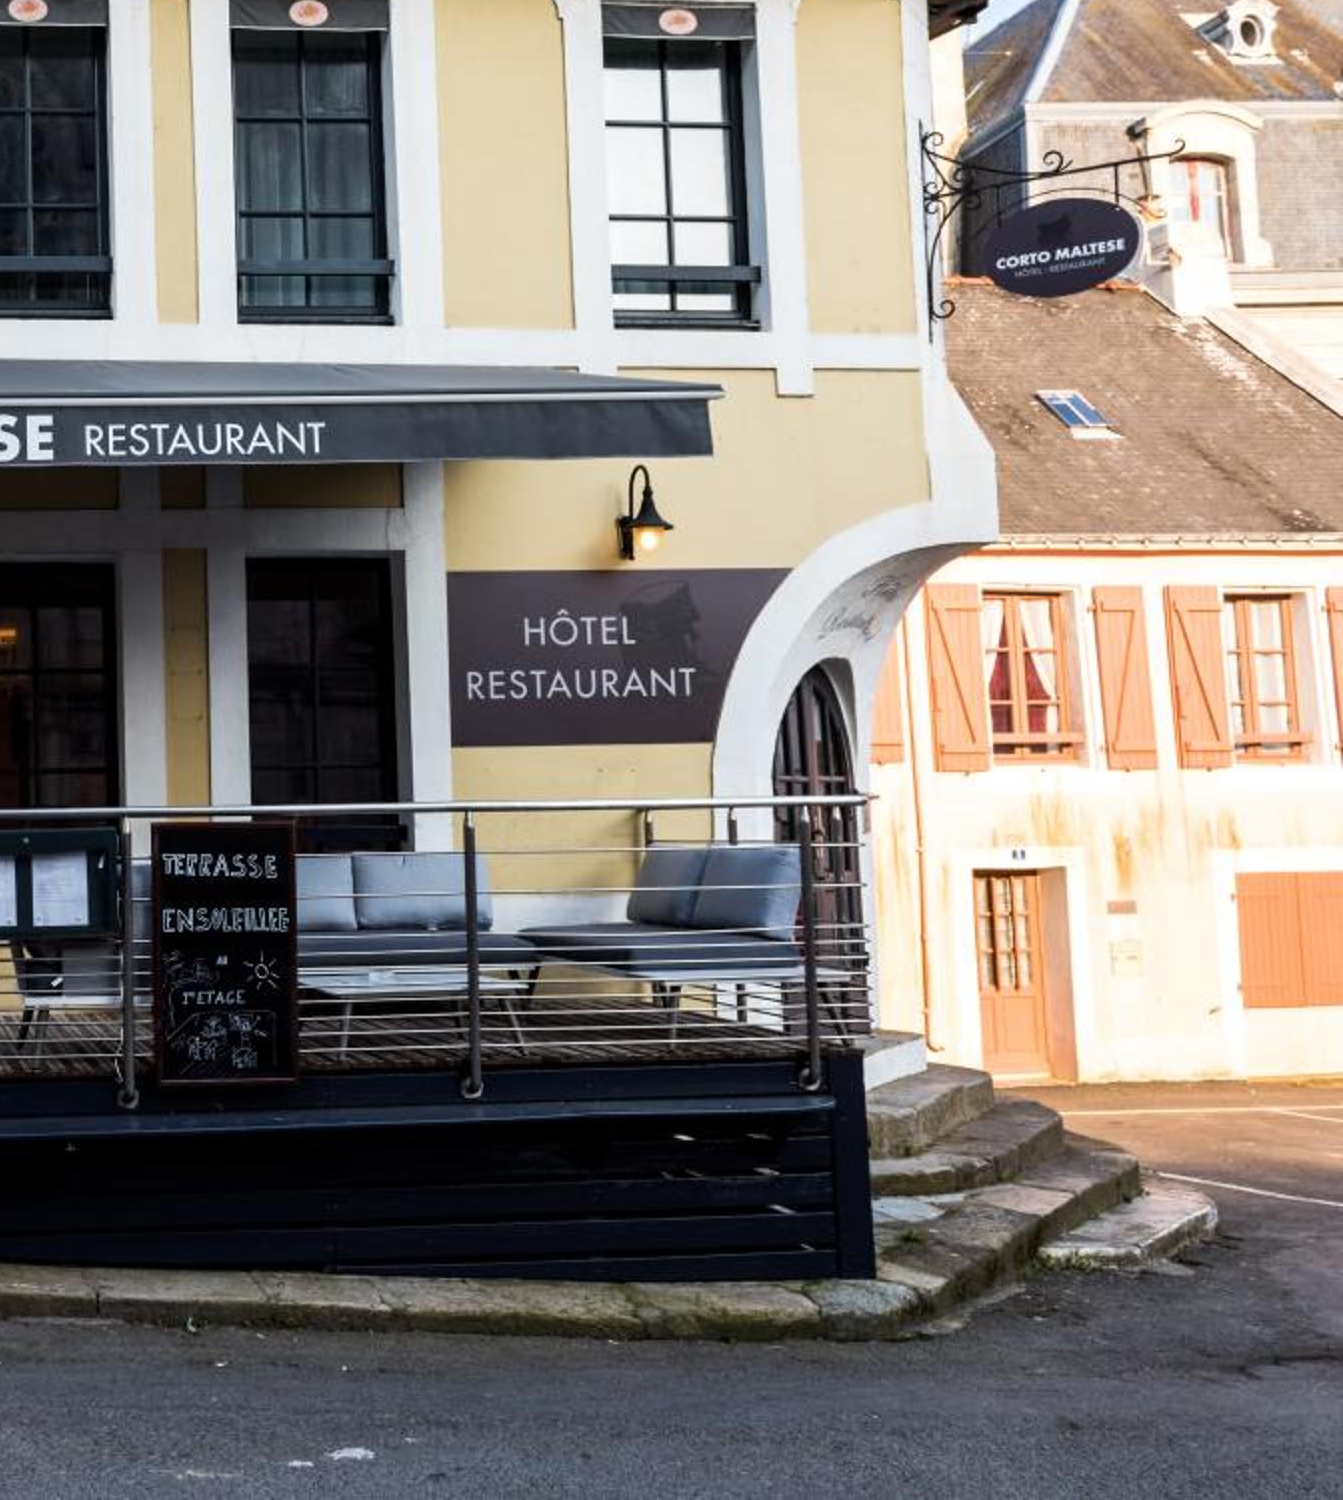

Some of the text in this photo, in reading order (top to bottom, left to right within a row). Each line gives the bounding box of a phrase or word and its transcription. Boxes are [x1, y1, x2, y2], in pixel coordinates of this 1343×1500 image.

[996, 238, 1125, 270] CORTO MALTESE
[85, 421, 326, 456] RESTAURANT
[524, 609, 636, 646] HÔTEL
[467, 668, 696, 700] RESTAURANT
[162, 853, 278, 879] TERRASSE
